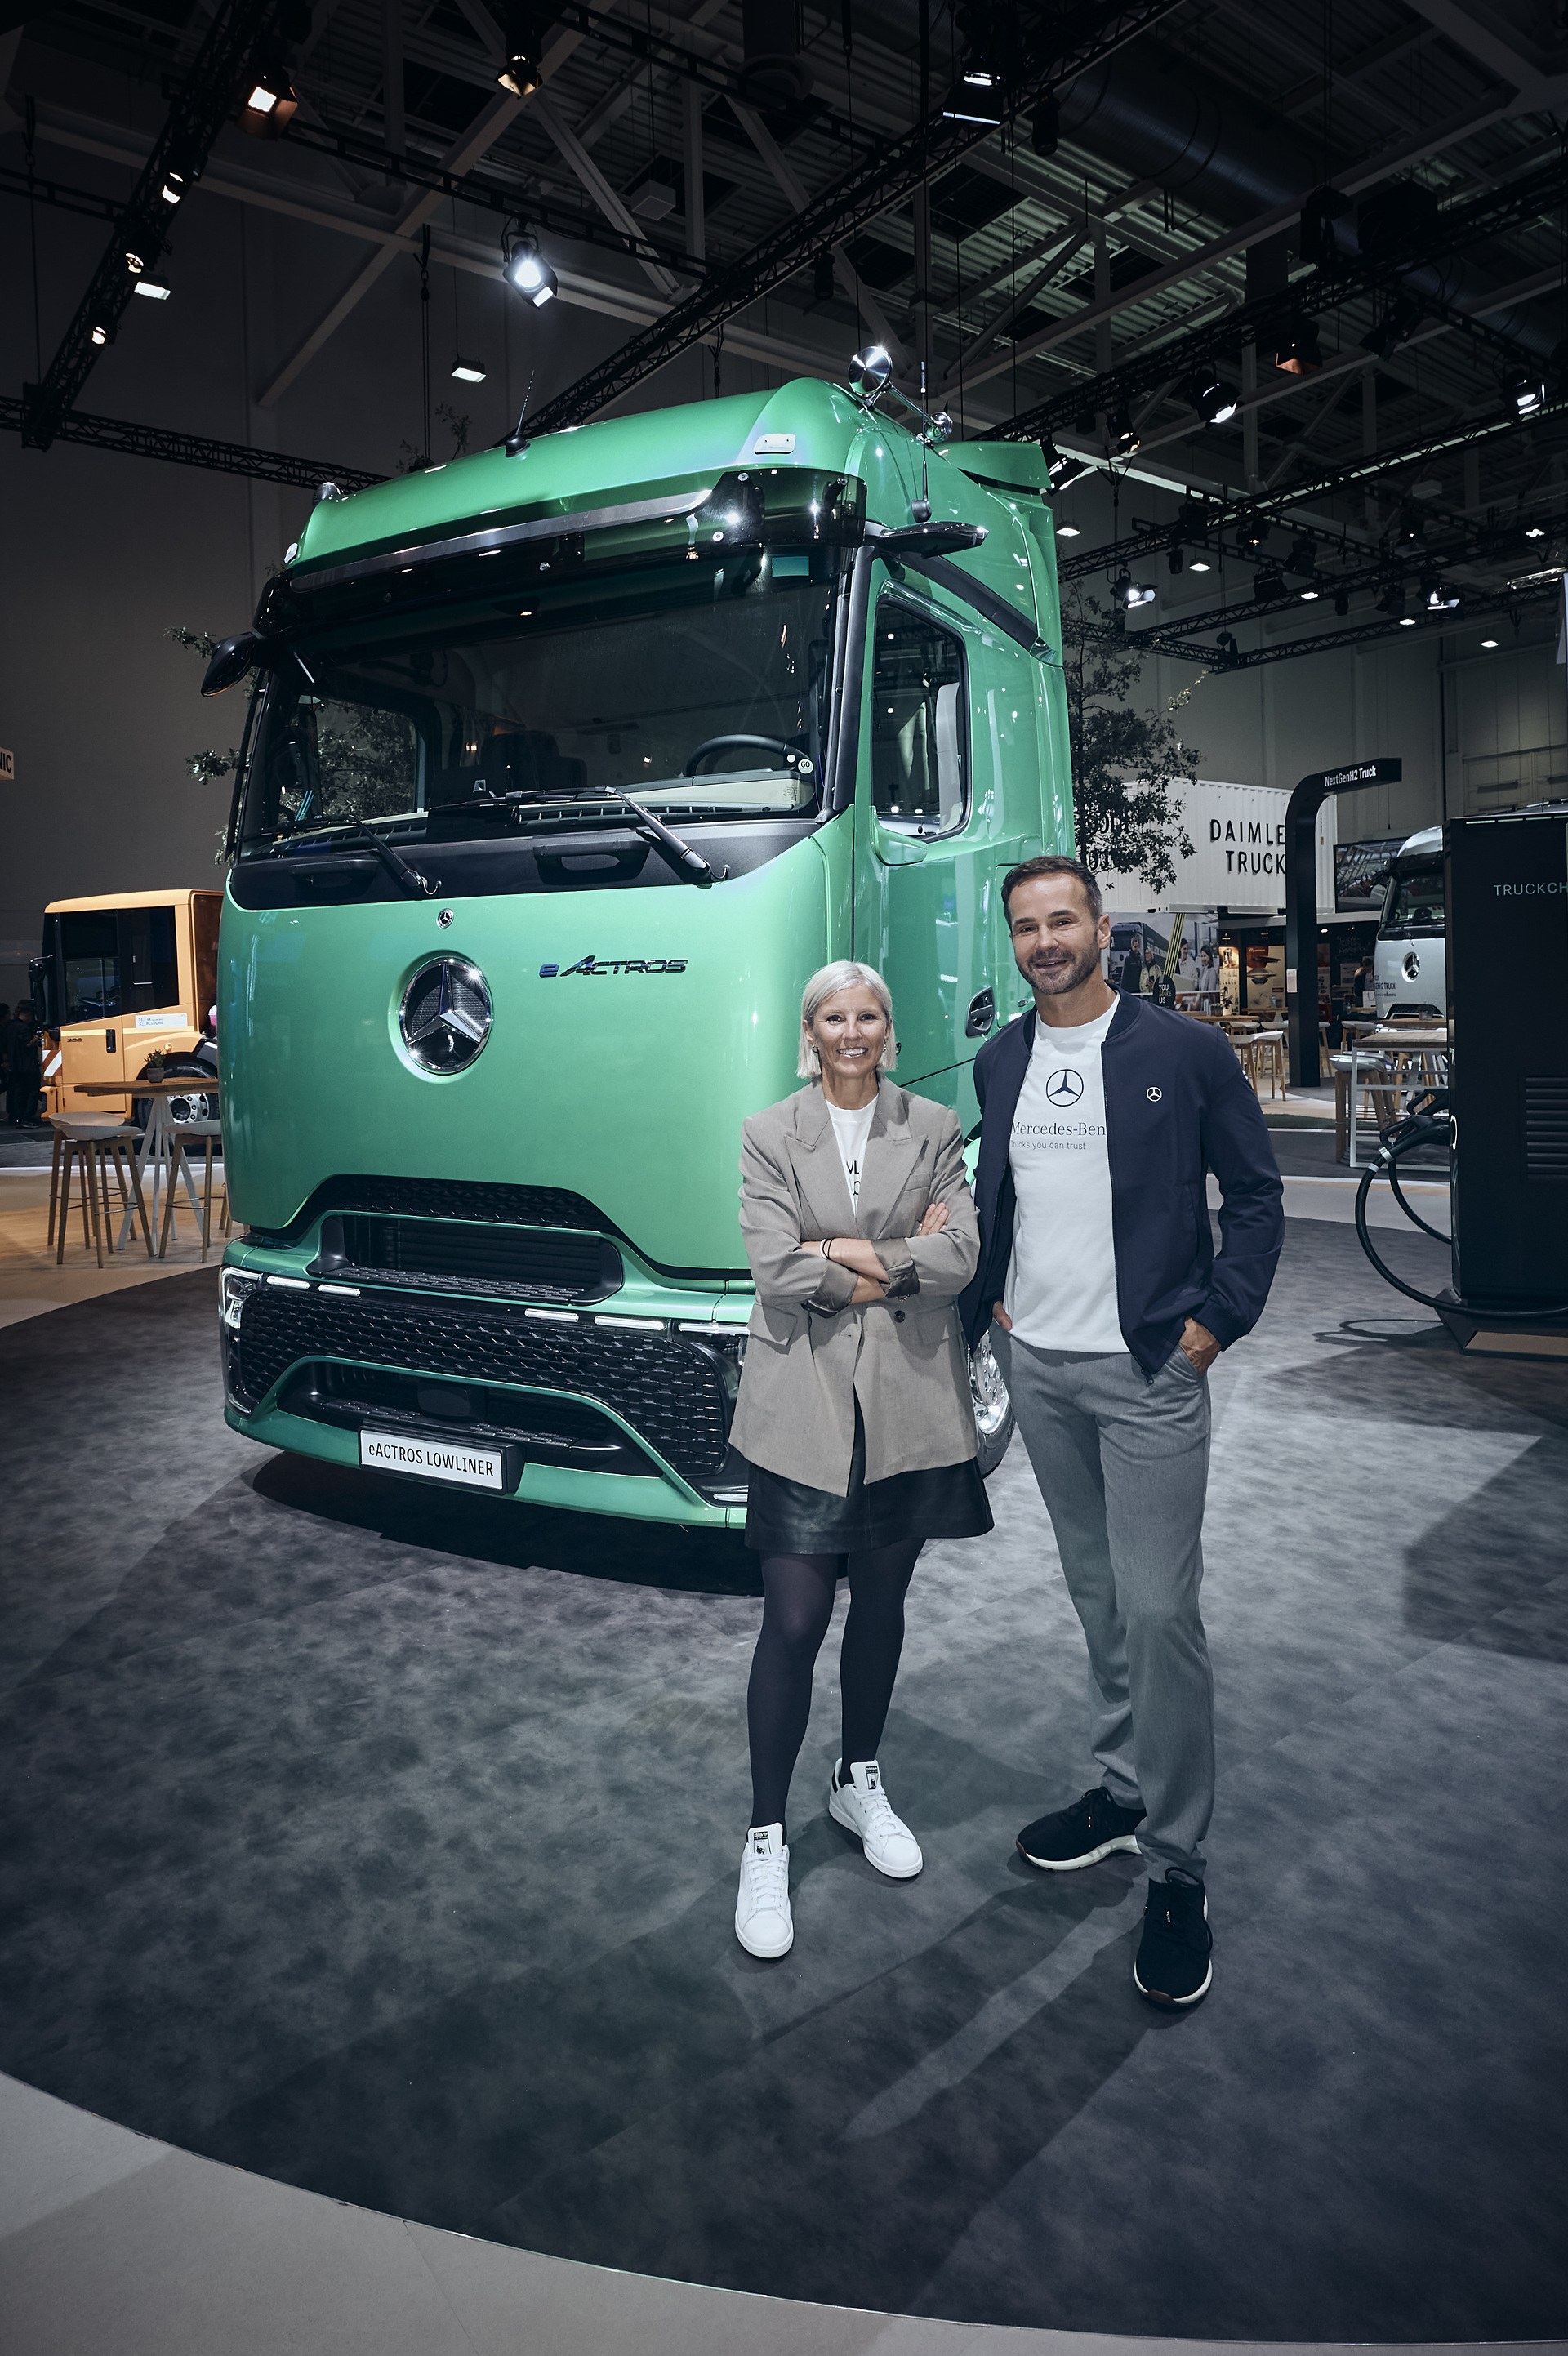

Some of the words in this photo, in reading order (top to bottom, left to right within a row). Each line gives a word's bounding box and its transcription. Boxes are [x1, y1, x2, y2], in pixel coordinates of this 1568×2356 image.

[1325, 769, 1358, 786] NextGenH2
[1359, 765, 1376, 779] Truck
[1210, 819, 1286, 845] DAIMLE
[1226, 850, 1286, 875] TRUCK
[1013, 1122, 1106, 1136] Mercedes-Ben
[368, 1442, 423, 1464] eACTROS
[426, 1450, 494, 1477] LOWLINER
